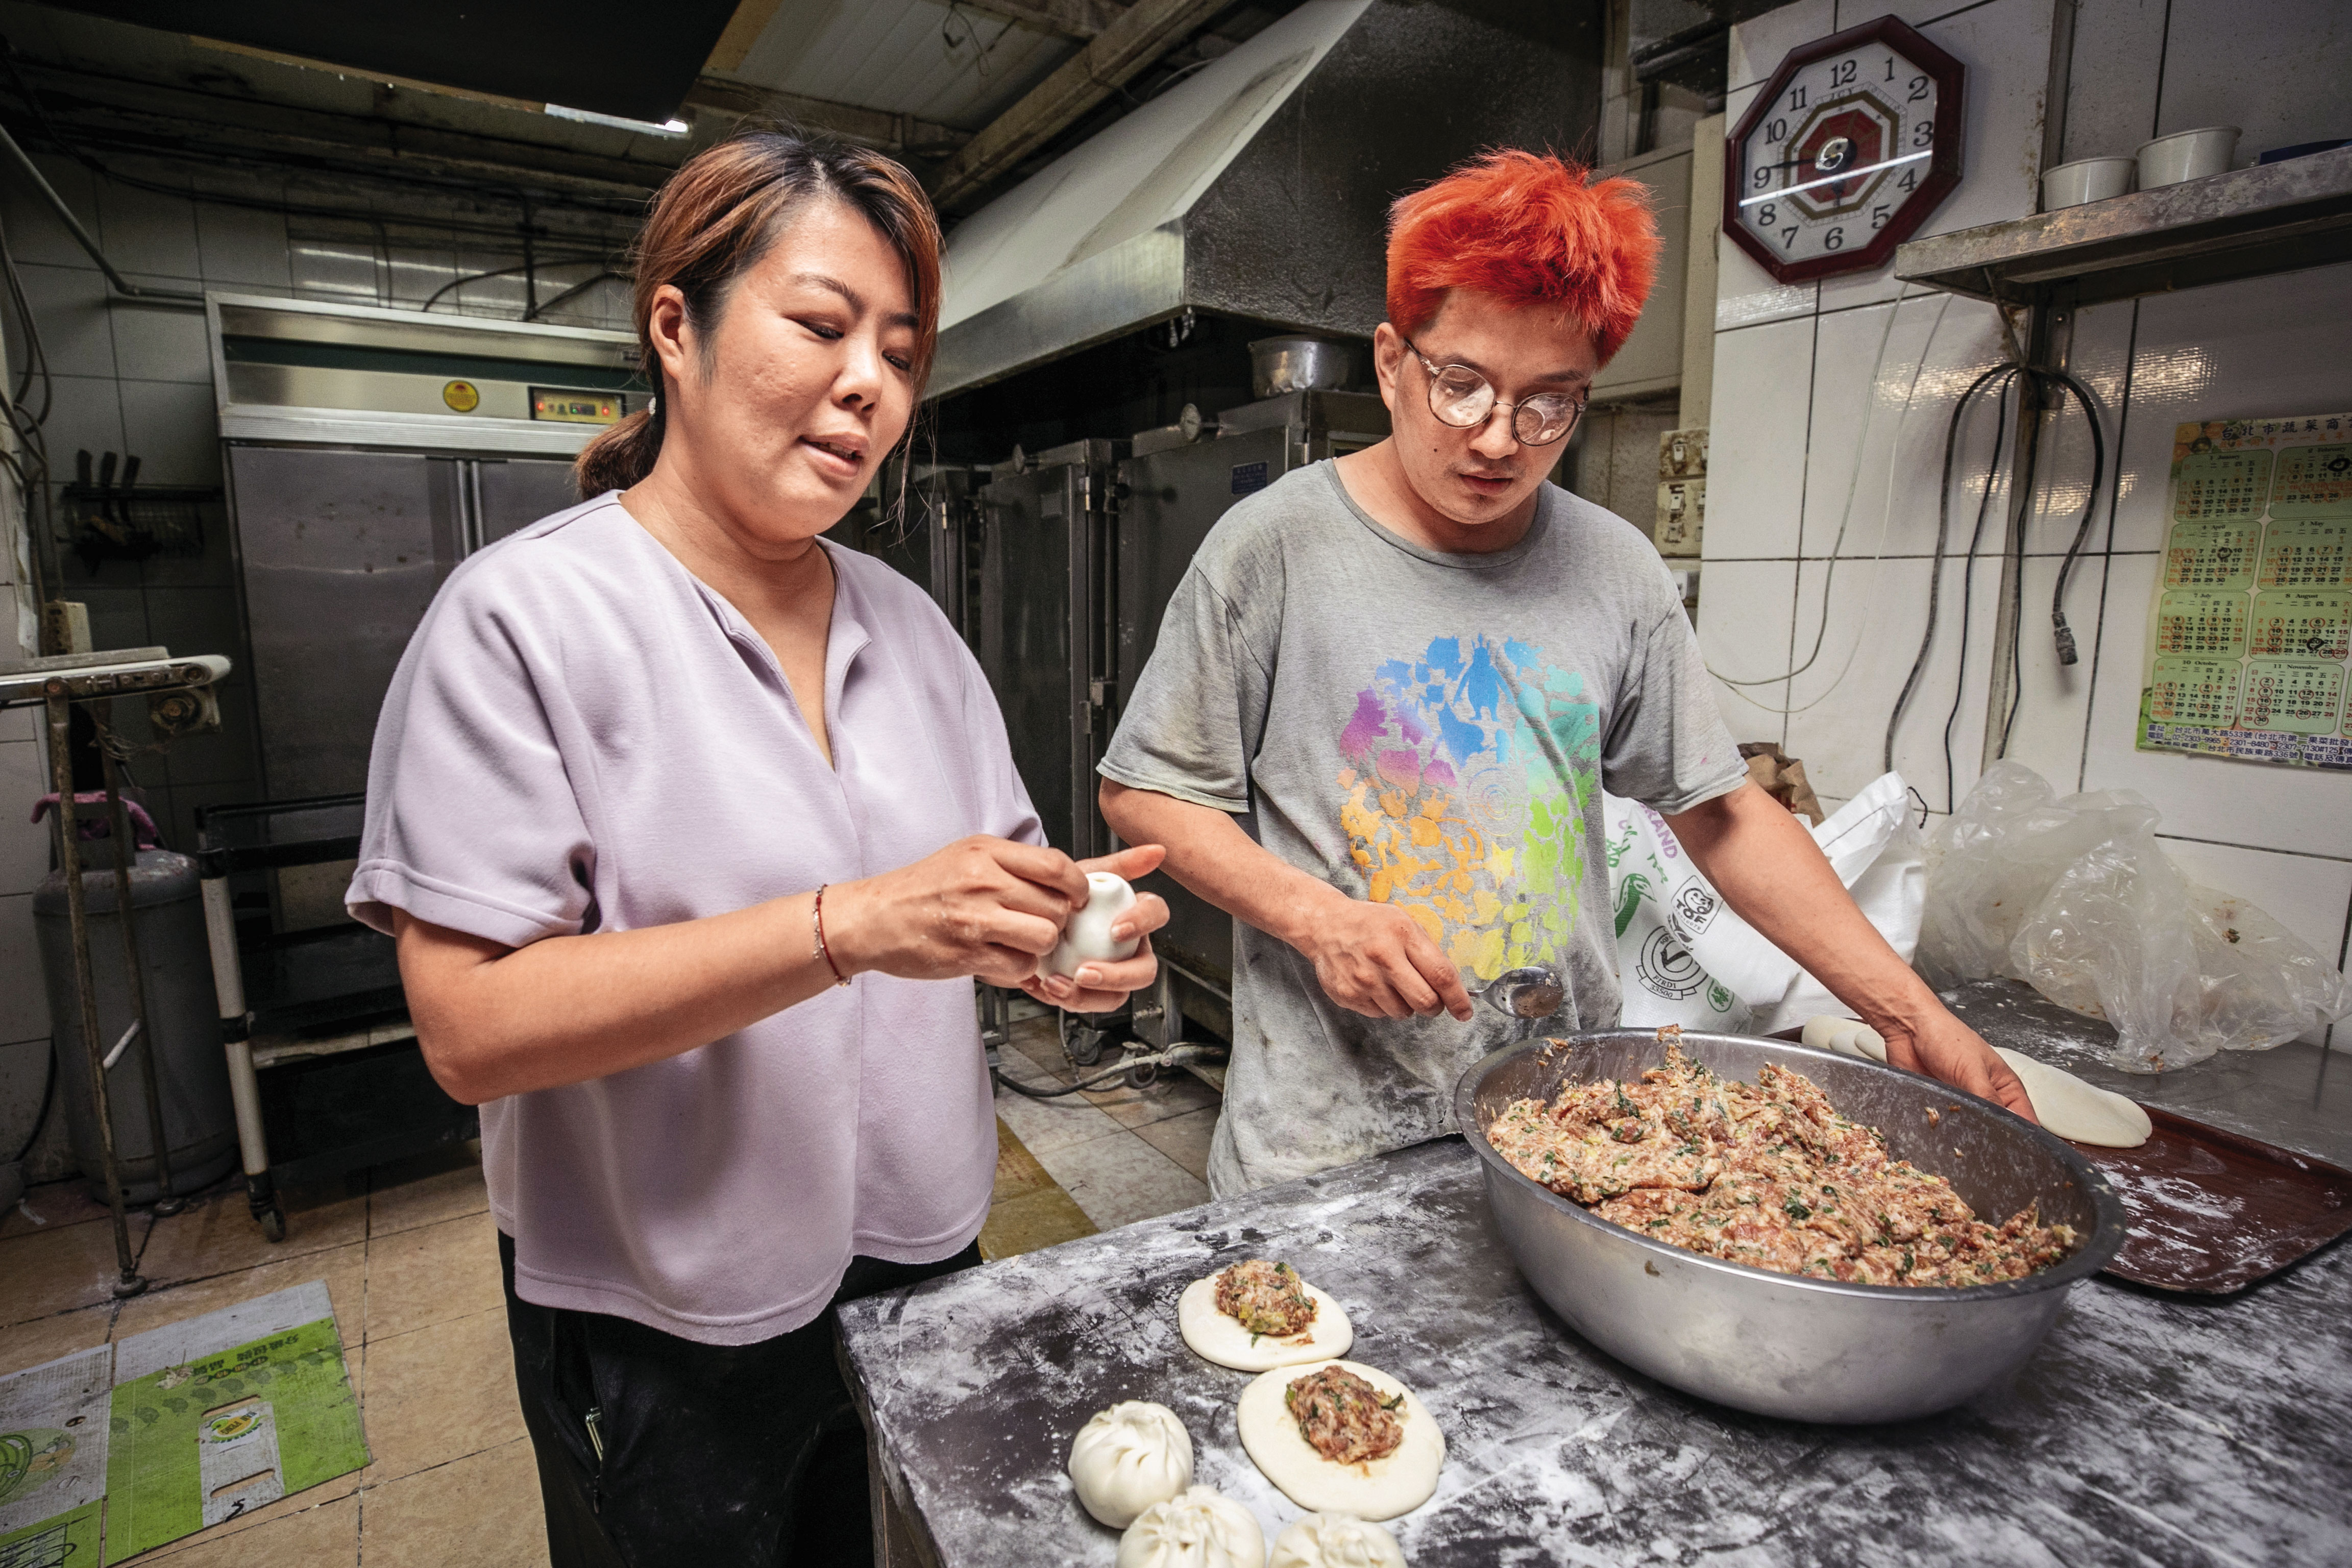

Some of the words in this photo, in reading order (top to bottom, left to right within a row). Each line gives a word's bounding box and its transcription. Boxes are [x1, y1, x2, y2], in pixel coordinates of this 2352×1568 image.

[1830, 60, 1857, 88] 12
[1885, 57, 1894, 82] 1
[1790, 86, 1807, 111] 11
[1908, 76, 1929, 103] 2
[1766, 119, 1786, 144] 10
[1914, 121, 1934, 146] 3
[1754, 166, 1771, 188] 9
[1898, 168, 1916, 192] 4
[1759, 204, 1776, 226] 8
[1872, 205, 1890, 228] 5
[1782, 226, 1799, 249] 7
[1825, 228, 1844, 250] 6
[1649, 984, 1674, 998] 33500
[1653, 974, 1677, 989] FIRDI
